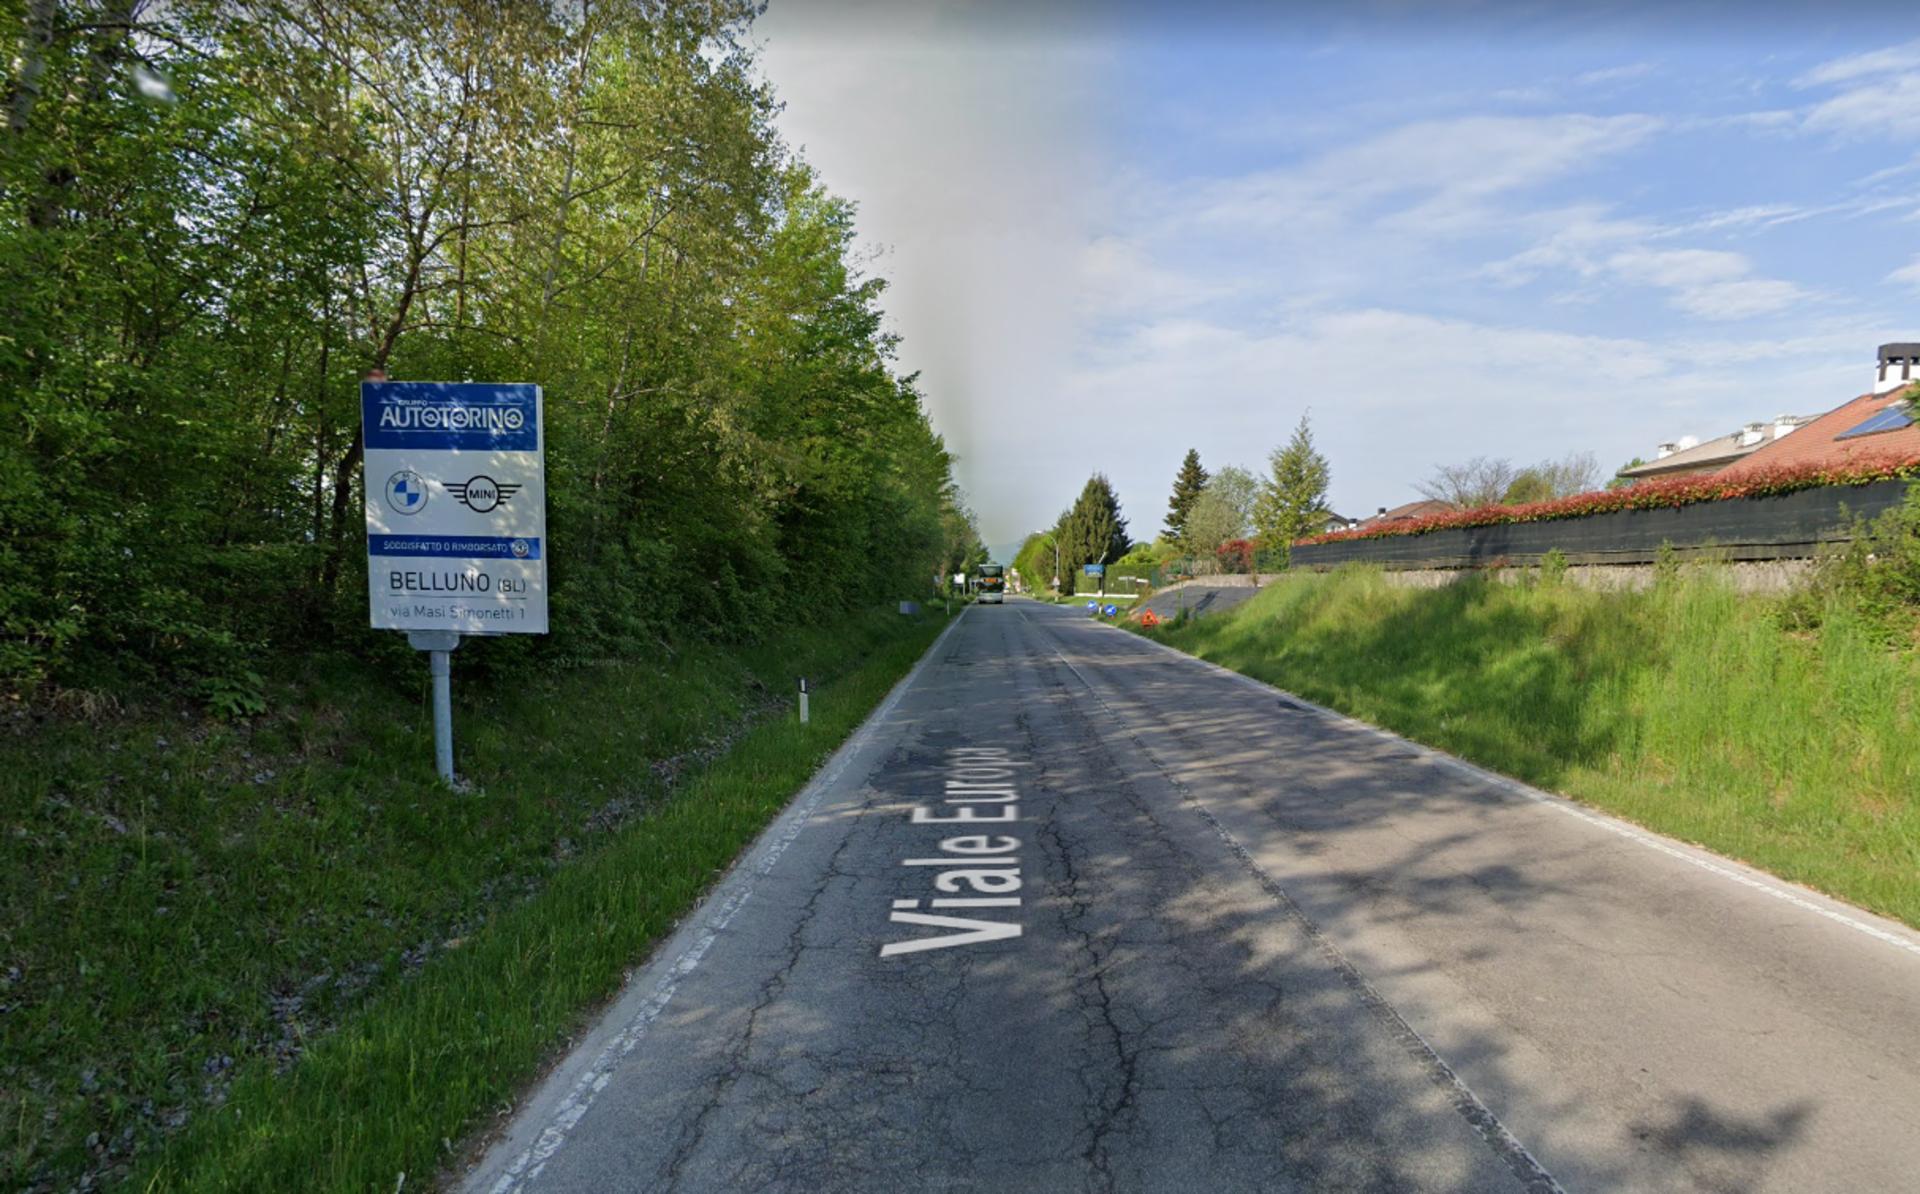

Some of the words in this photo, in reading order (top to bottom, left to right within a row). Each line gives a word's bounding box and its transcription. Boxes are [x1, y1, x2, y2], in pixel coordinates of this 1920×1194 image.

[380, 406, 524, 428] AUTOTORINO
[469, 489, 496, 500] MINI
[390, 571, 490, 592] BELLUNO
[497, 578, 526, 593] (BL)
[391, 607, 410, 618] via
[414, 605, 446, 618] Masi
[450, 605, 515, 620] Simonetti
[520, 608, 525, 619] 1
